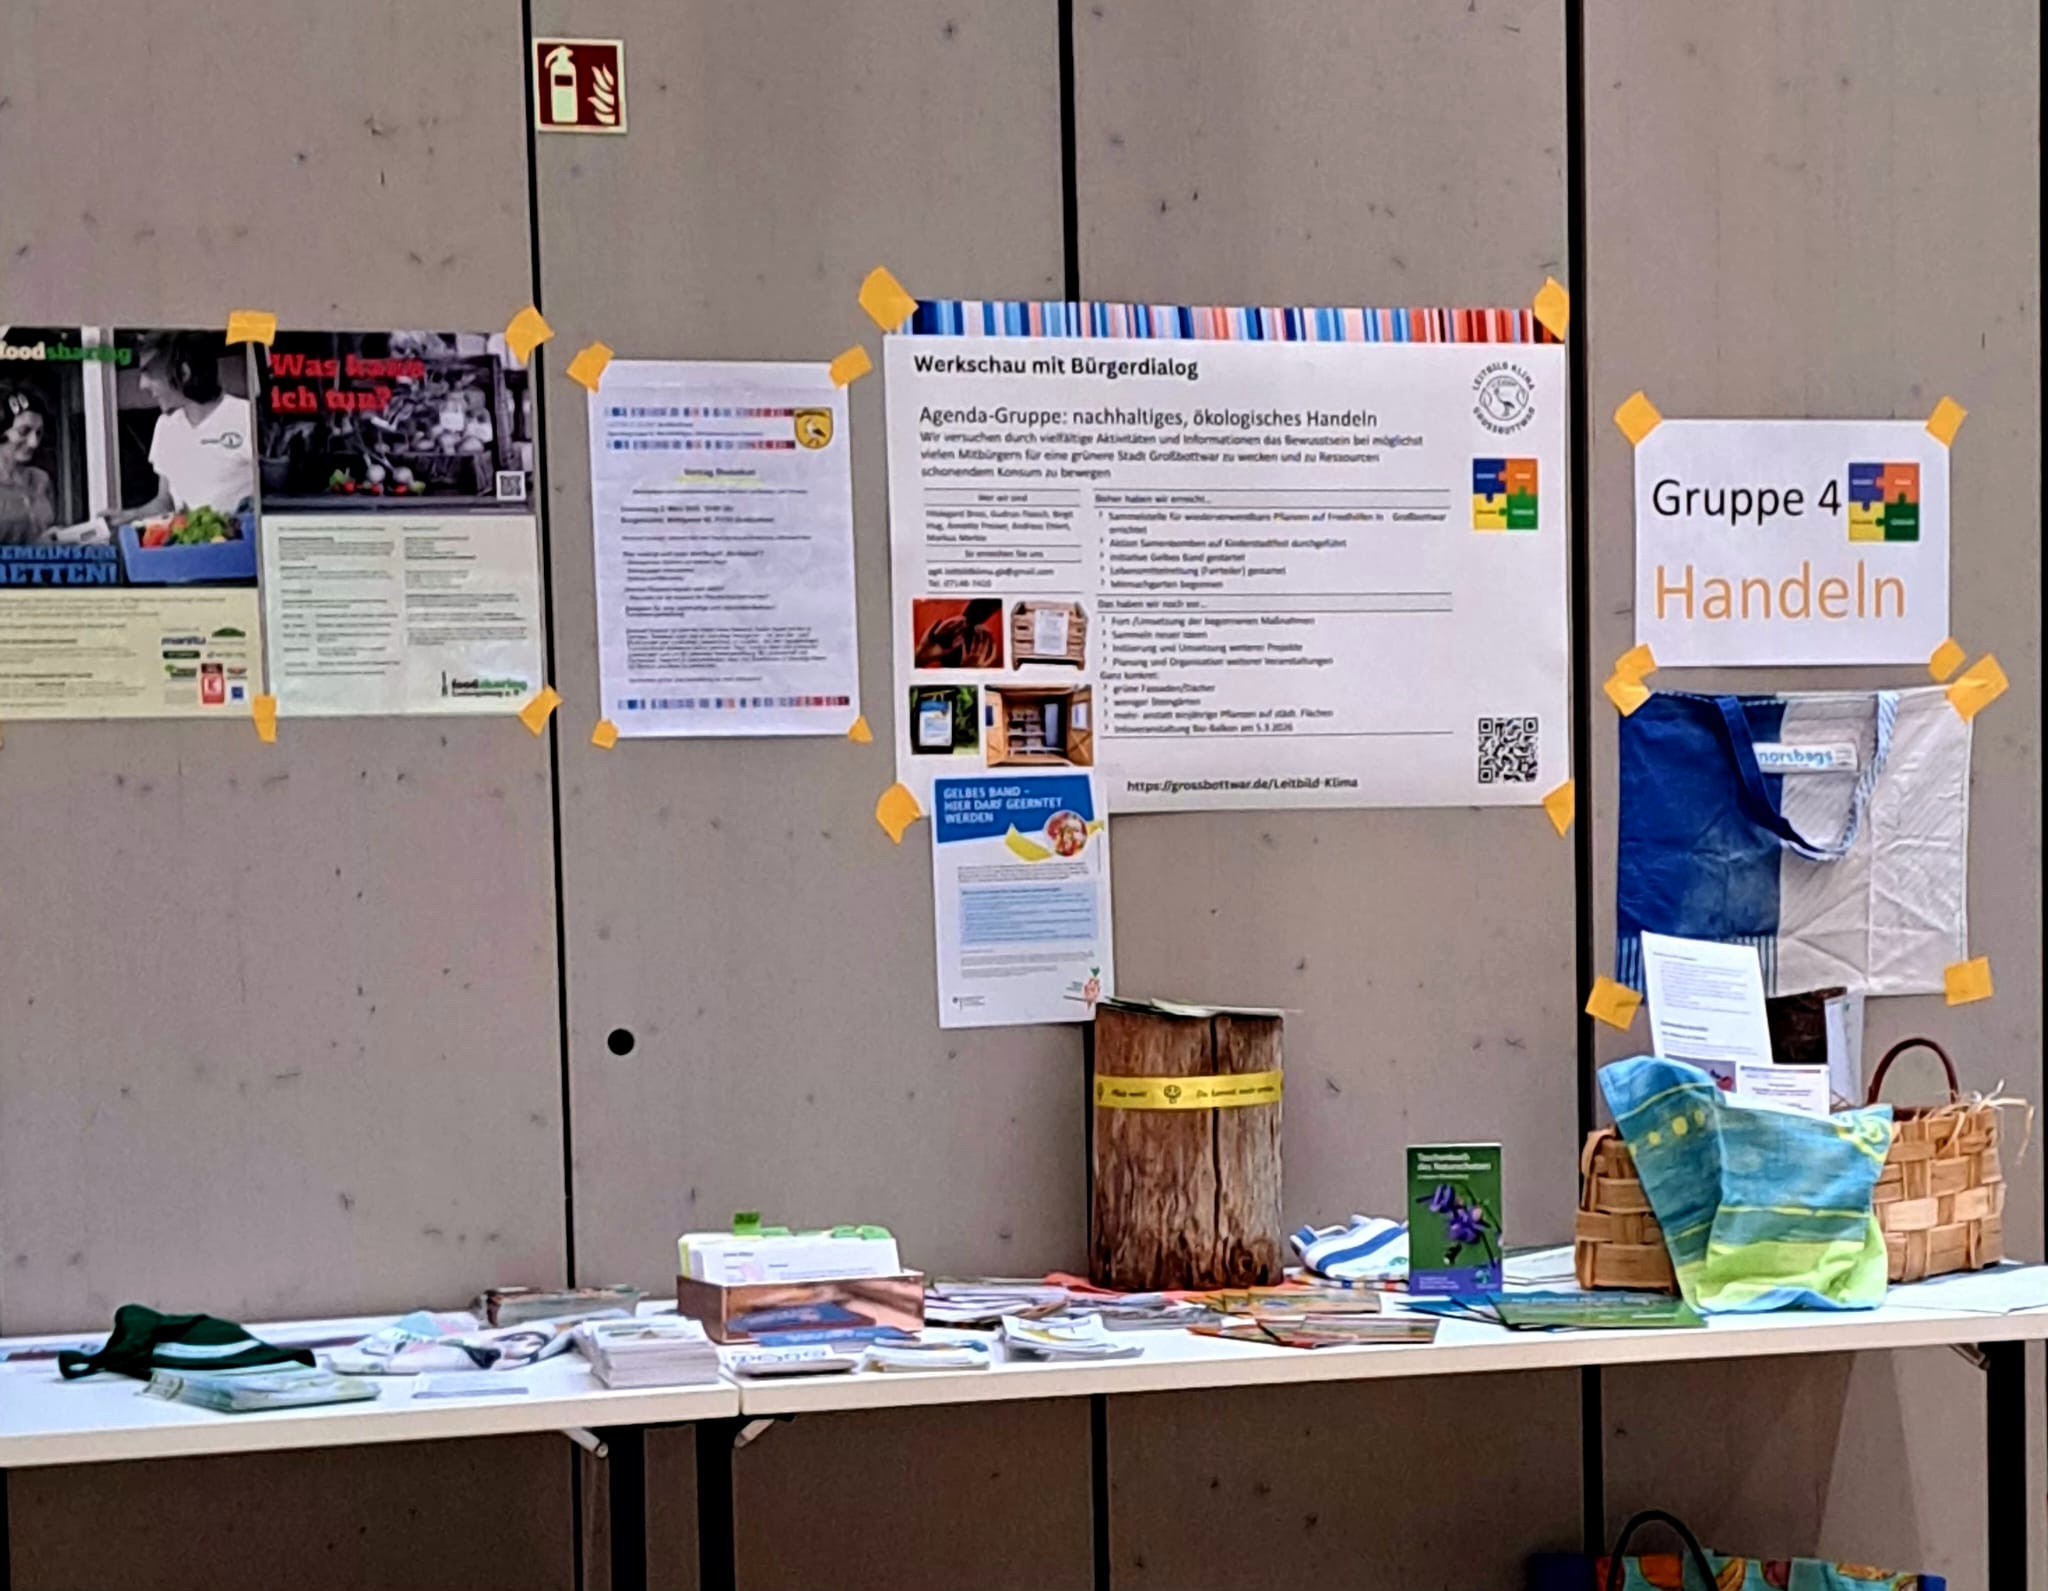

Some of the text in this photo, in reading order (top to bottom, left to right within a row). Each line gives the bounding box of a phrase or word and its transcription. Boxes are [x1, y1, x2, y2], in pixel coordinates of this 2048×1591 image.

[271, 353, 337, 377] Was
[914, 355, 1199, 380] Werkschau mit Bürgerdialog
[1511, 363, 1535, 391] KLIMA
[271, 385, 318, 411] ich
[919, 406, 1377, 430] Agenda-Gruppe: nachhaltiges, ökologisches Handeln
[920, 431, 940, 443] Wir
[943, 432, 1001, 443] versuchen
[1004, 431, 1037, 443] durch
[1040, 431, 1093, 445] vielfältige
[1096, 432, 1156, 445] Aktivitäten
[1160, 433, 1180, 445] und
[1183, 434, 1260, 446] Informationen
[1263, 434, 1282, 446] das
[1353, 434, 1370, 446] bei
[1372, 434, 1423, 448] möglichst
[920, 449, 1380, 464] vielen Mitbürgern für eine grünere Stadt Großbottwar zu wecken und zu Ressourcen
[921, 466, 1111, 480] schonendem Konsum zu bewegen
[1652, 478, 1842, 526] Gruppe 4
[0, 545, 117, 560] EMEINSAM
[1655, 559, 1905, 620] Handeln
[943, 786, 986, 799] GELBES
[988, 785, 1021, 798] BAND
[944, 797, 1063, 812] HIER DARF GEERNTET
[944, 811, 994, 824] WERDEN
